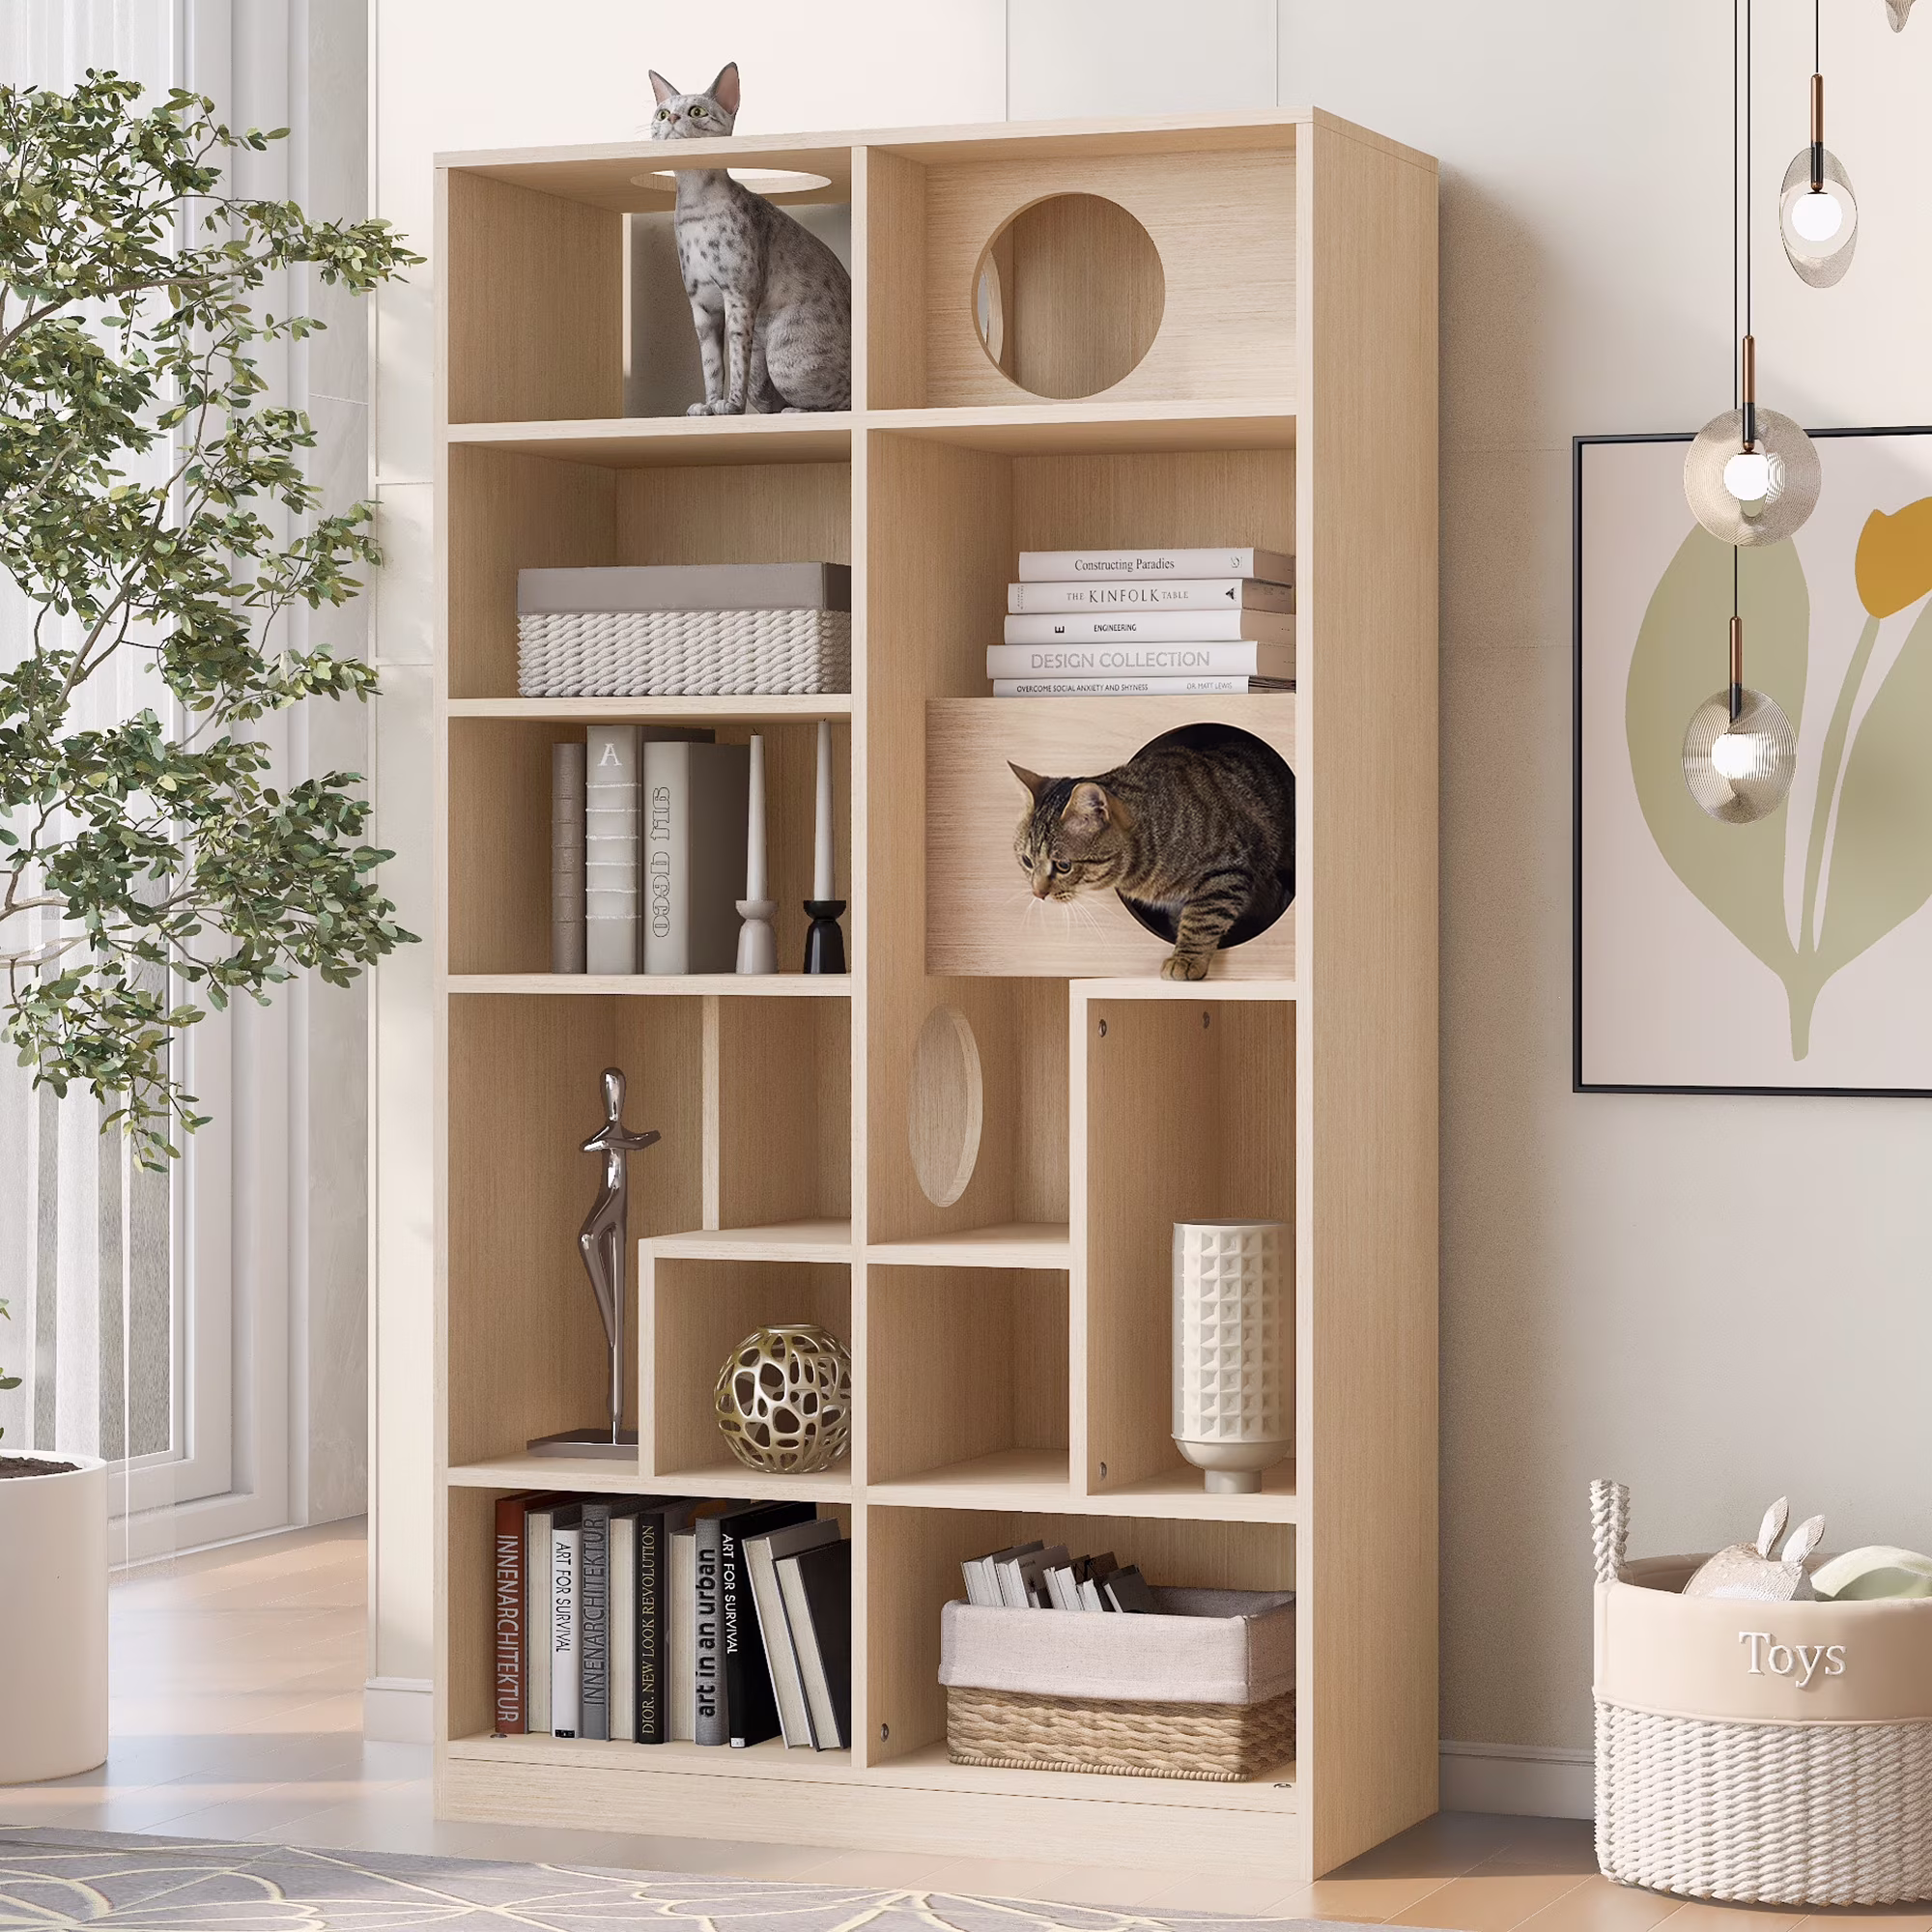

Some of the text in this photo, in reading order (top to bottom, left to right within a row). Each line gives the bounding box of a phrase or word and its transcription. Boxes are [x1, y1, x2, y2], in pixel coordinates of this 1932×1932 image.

[1074, 557, 1175, 573] Constructing Paradies
[1066, 588, 1189, 604] THE KINFOLK TABLE
[1094, 623, 1137, 633] ENGINEERING
[1031, 651, 1210, 669] DESIGN COLLECTION
[1053, 684, 1075, 693] SOCIAL
[1121, 683, 1149, 692] SHYNESS
[597, 743, 622, 766] A
[555, 1542, 571, 1653] ART FOR SURVIVAL
[583, 1518, 605, 1707] INNENARCHITEKTUR
[722, 1533, 738, 1655] ART FOR SURVIVAL
[497, 1534, 519, 1723] INNENARCHITEKTUR
[641, 1525, 655, 1735] DIOR. NEW LOOK REVOLUTION
[696, 1548, 716, 1718] art in an urban
[1739, 1632, 1847, 1689] Toys
